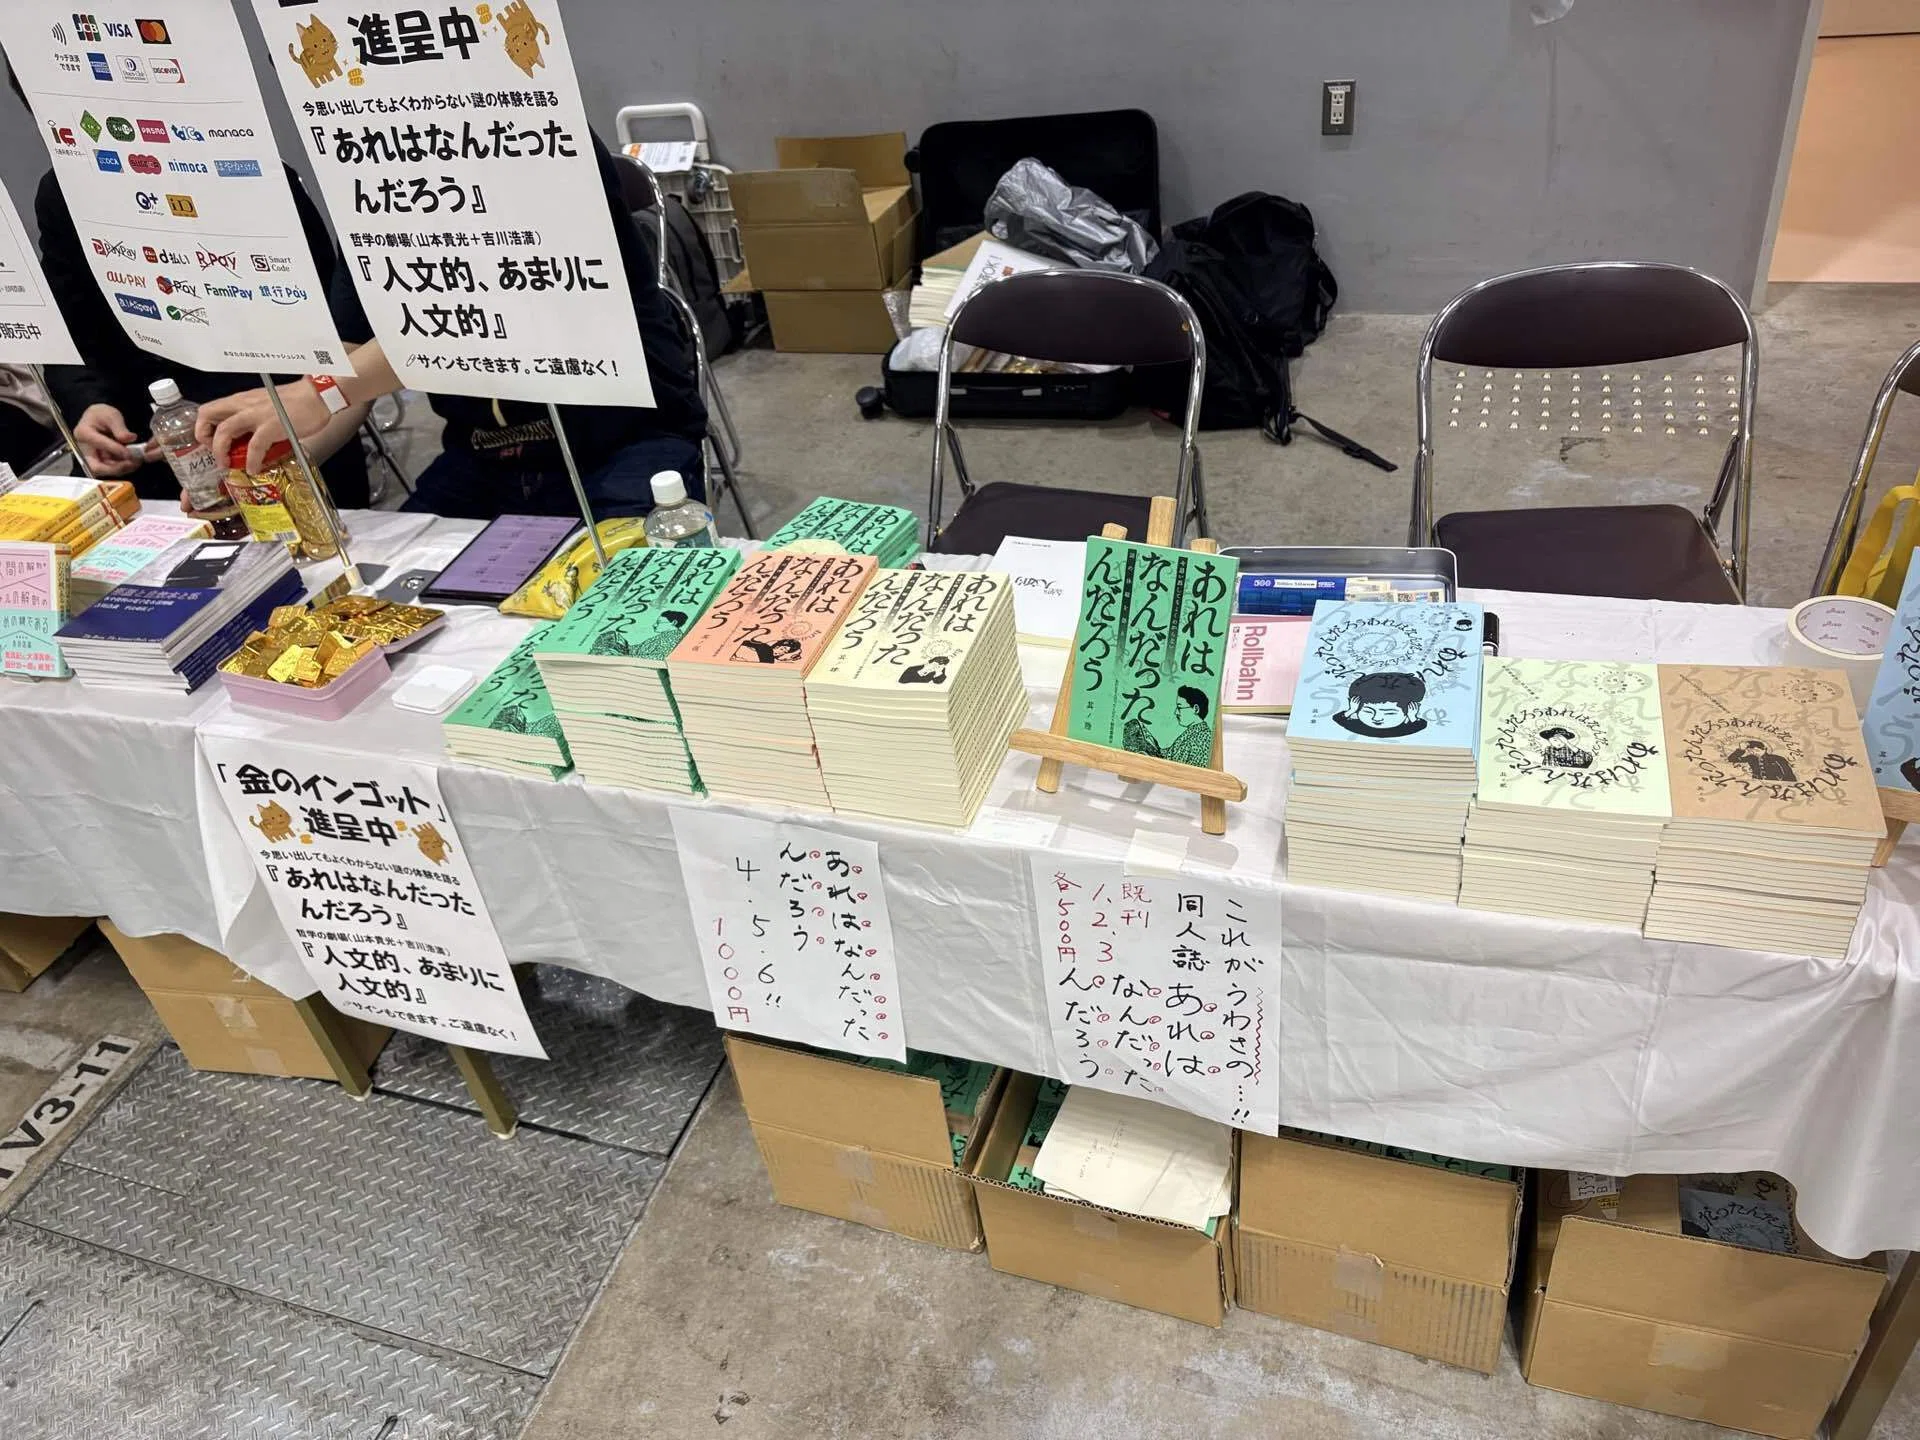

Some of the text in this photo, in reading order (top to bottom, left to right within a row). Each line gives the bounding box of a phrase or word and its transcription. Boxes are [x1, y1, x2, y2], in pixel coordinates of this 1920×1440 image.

[103, 22, 133, 38] VISA
[347, 6, 481, 67] 進呈中
[152, 67, 179, 75] DISCOVER
[302, 91, 560, 117] 今思い出してもよくわからない謎の体験を語る
[208, 127, 255, 138] manaca
[310, 119, 578, 165] 『あれはなんだった
[168, 159, 208, 174] nimoca
[354, 175, 487, 215] んだろう』
[269, 255, 291, 264] Smart
[271, 263, 290, 272] Code
[356, 256, 610, 294] 『人文的、あまりに
[204, 283, 252, 300] FamiPay
[400, 302, 508, 340] 人文的』
[845, 508, 900, 554] あれは
[577, 551, 638, 622] んだろう
[597, 549, 685, 634] なんだった
[673, 549, 728, 607] あれは
[707, 554, 774, 630] んだろう
[733, 557, 821, 645] なんだった
[805, 558, 864, 614] あれは
[943, 574, 997, 632] あれは
[841, 572, 903, 650] んだろう
[872, 572, 949, 665] なんだった
[1080, 546, 1123, 692] んだろう
[1120, 551, 1171, 725] なんだった
[1180, 561, 1227, 677] あれは
[1236, 624, 1268, 701] Rollbahn
[216, 763, 448, 824] 「金のインゴット」
[298, 804, 399, 847] 進呈中
[260, 849, 461, 886] 今思い出してもよくわからない謎の体験を語る
[265, 864, 476, 916] 『あれはなんだった
[300, 897, 409, 930] んだろう』
[779, 842, 813, 952] んだろう
[1053, 871, 1082, 963] 各500円
[1120, 882, 1152, 928] 既刊
[302, 941, 505, 992] 『人文的、あまりに
[713, 917, 750, 1023] 1000円
[825, 850, 872, 1041] あれはなんだった
[337, 971, 428, 1004] 人文的』
[1059, 967, 1103, 1079] んだろう
[1112, 974, 1153, 1093] なんだった
